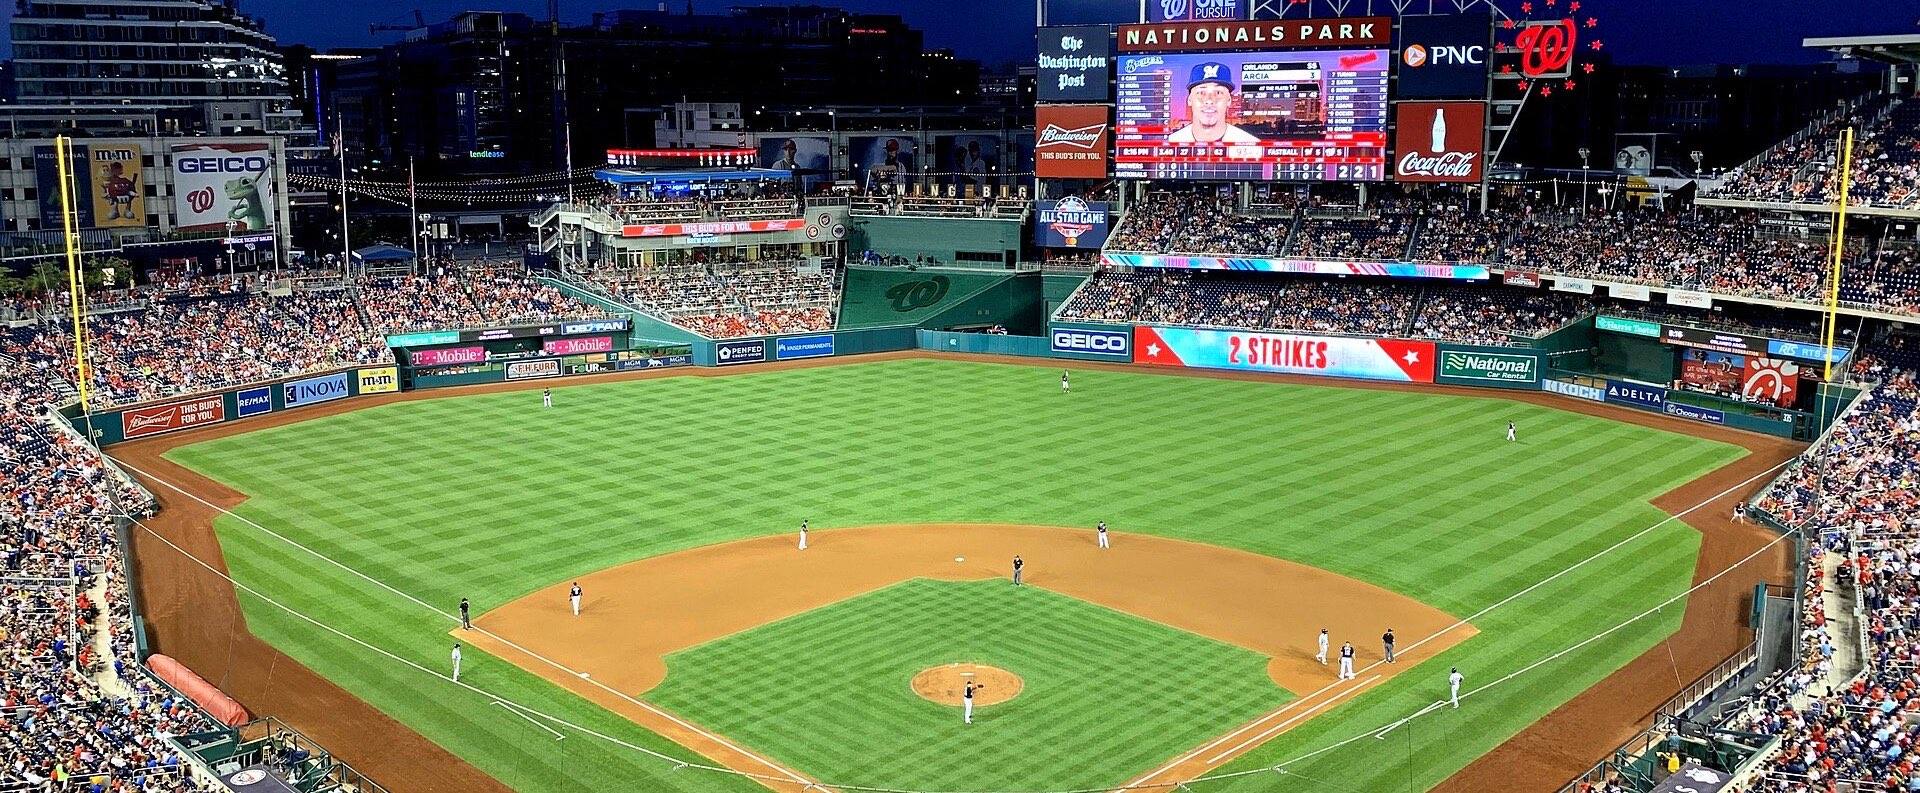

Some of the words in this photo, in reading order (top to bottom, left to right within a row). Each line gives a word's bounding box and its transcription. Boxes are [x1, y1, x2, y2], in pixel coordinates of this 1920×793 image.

[1195, 7, 1235, 18] PURSUIT
[1127, 26, 1284, 45] NATIONALS
[1301, 23, 1374, 40] PARK
[1061, 36, 1084, 51] The
[1430, 45, 1483, 64] PNC
[1038, 53, 1106, 71] Washington
[1058, 74, 1085, 90] Post
[1041, 128, 1100, 141] Budweiser
[470, 150, 504, 158] lendlease
[178, 157, 265, 172] GEICO
[1398, 151, 1477, 176] Coca-Cola
[1303, 172, 1309, 180] 0
[1339, 165, 1348, 178] 2
[1354, 165, 1363, 178] 2
[1371, 165, 1377, 179] 1
[1080, 213, 1105, 224] GAME
[681, 225, 698, 234] THIS
[720, 223, 734, 232] FOR
[1289, 261, 1316, 272] STRIKES
[1424, 265, 1452, 276] STRIKES
[1055, 333, 1126, 351] GEICO
[732, 346, 762, 354] PENFED
[1230, 336, 1241, 363] 2
[1248, 337, 1328, 369] STRIKES
[1502, 372, 1527, 380] Rental
[301, 378, 346, 399] INOVA
[1621, 388, 1661, 403] DELTA
[180, 404, 198, 414] THIS
[199, 400, 221, 411] BUD'S
[239, 394, 269, 407] RE/MAX
[181, 414, 197, 424] FOR
[198, 411, 215, 421] YOU.
[1676, 408, 1699, 418] Choose
[131, 414, 172, 428] Budweiser
